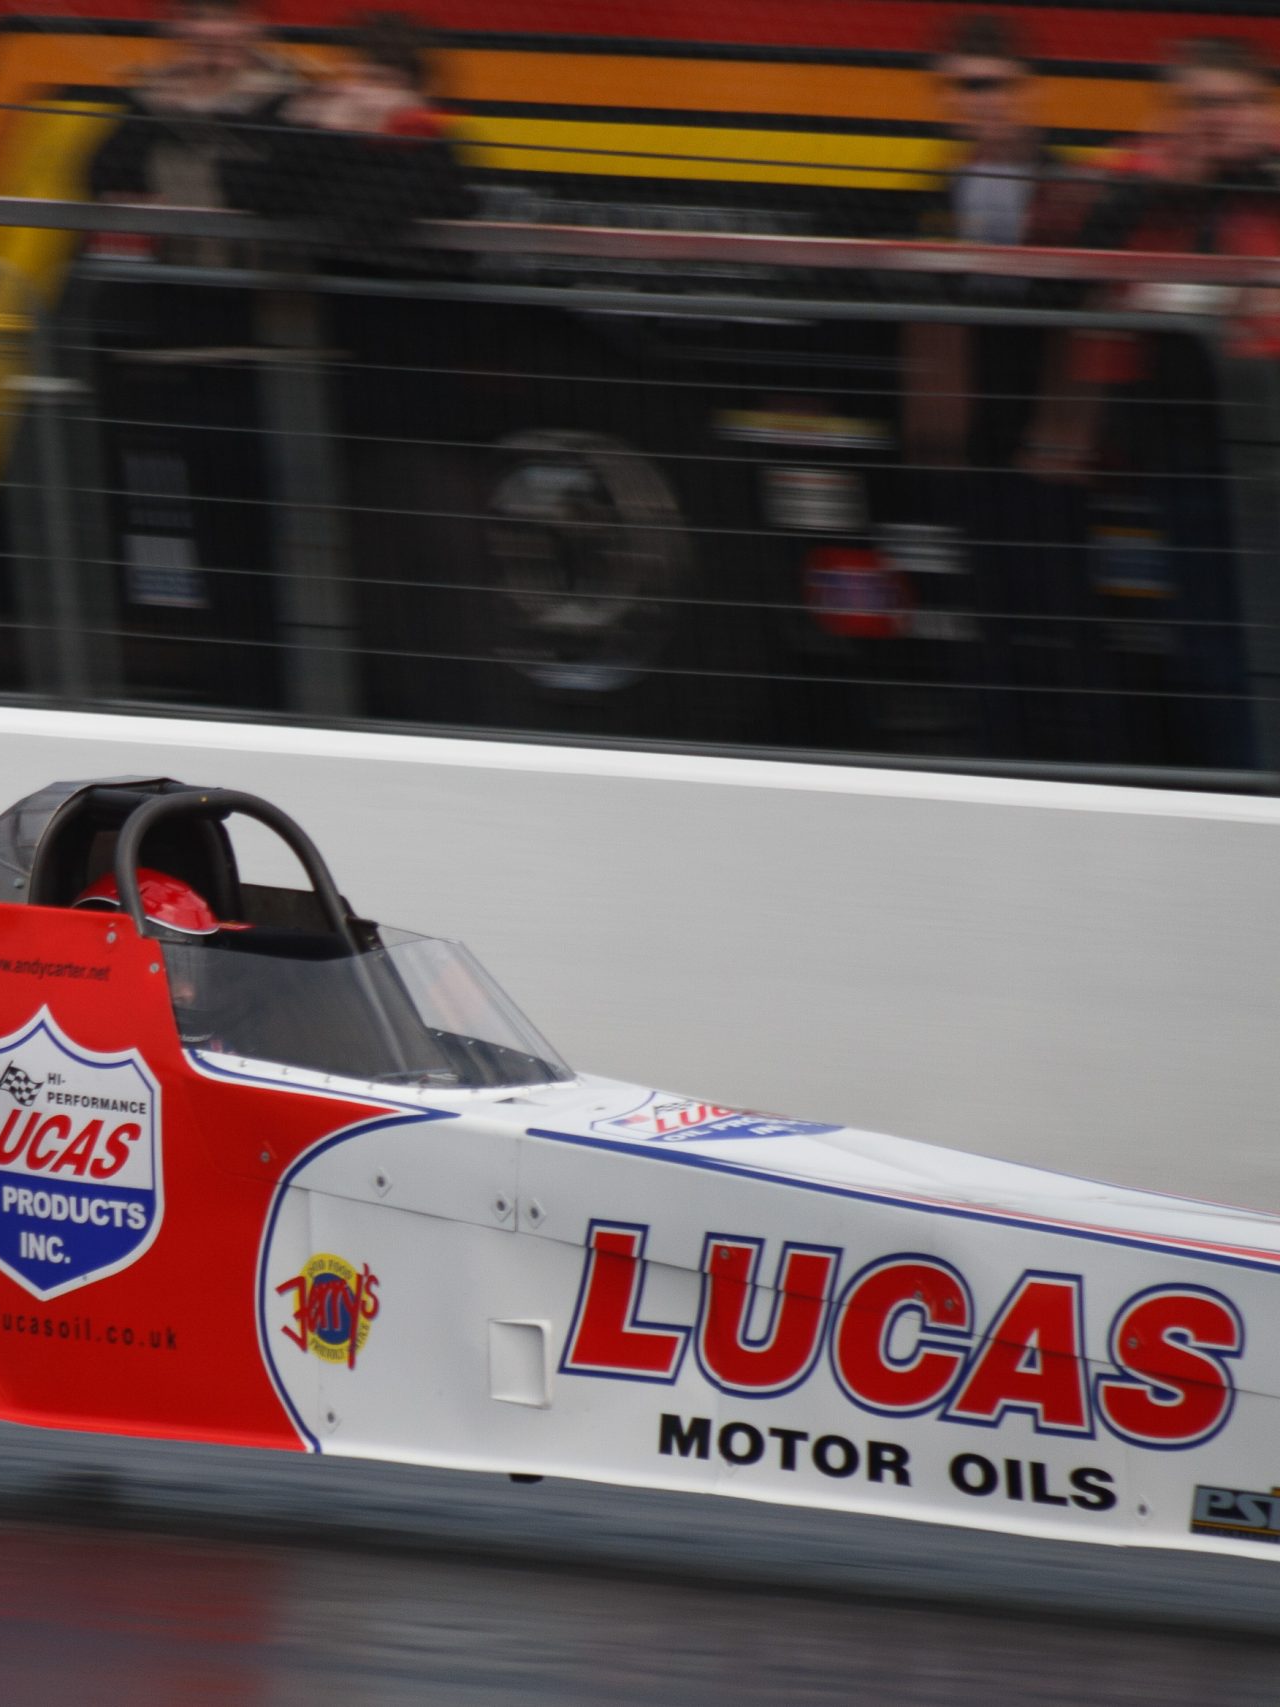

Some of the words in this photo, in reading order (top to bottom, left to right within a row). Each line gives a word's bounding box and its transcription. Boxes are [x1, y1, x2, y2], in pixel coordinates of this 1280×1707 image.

[47, 1092, 147, 1115] PERFORMANCE
[2, 1185, 147, 1230] PRODUCTS
[20, 1231, 71, 1264] INC.
[557, 1218, 1245, 1451] LUCAS
[658, 1413, 912, 1486] MOTOR
[948, 1452, 1118, 1511] OILS
